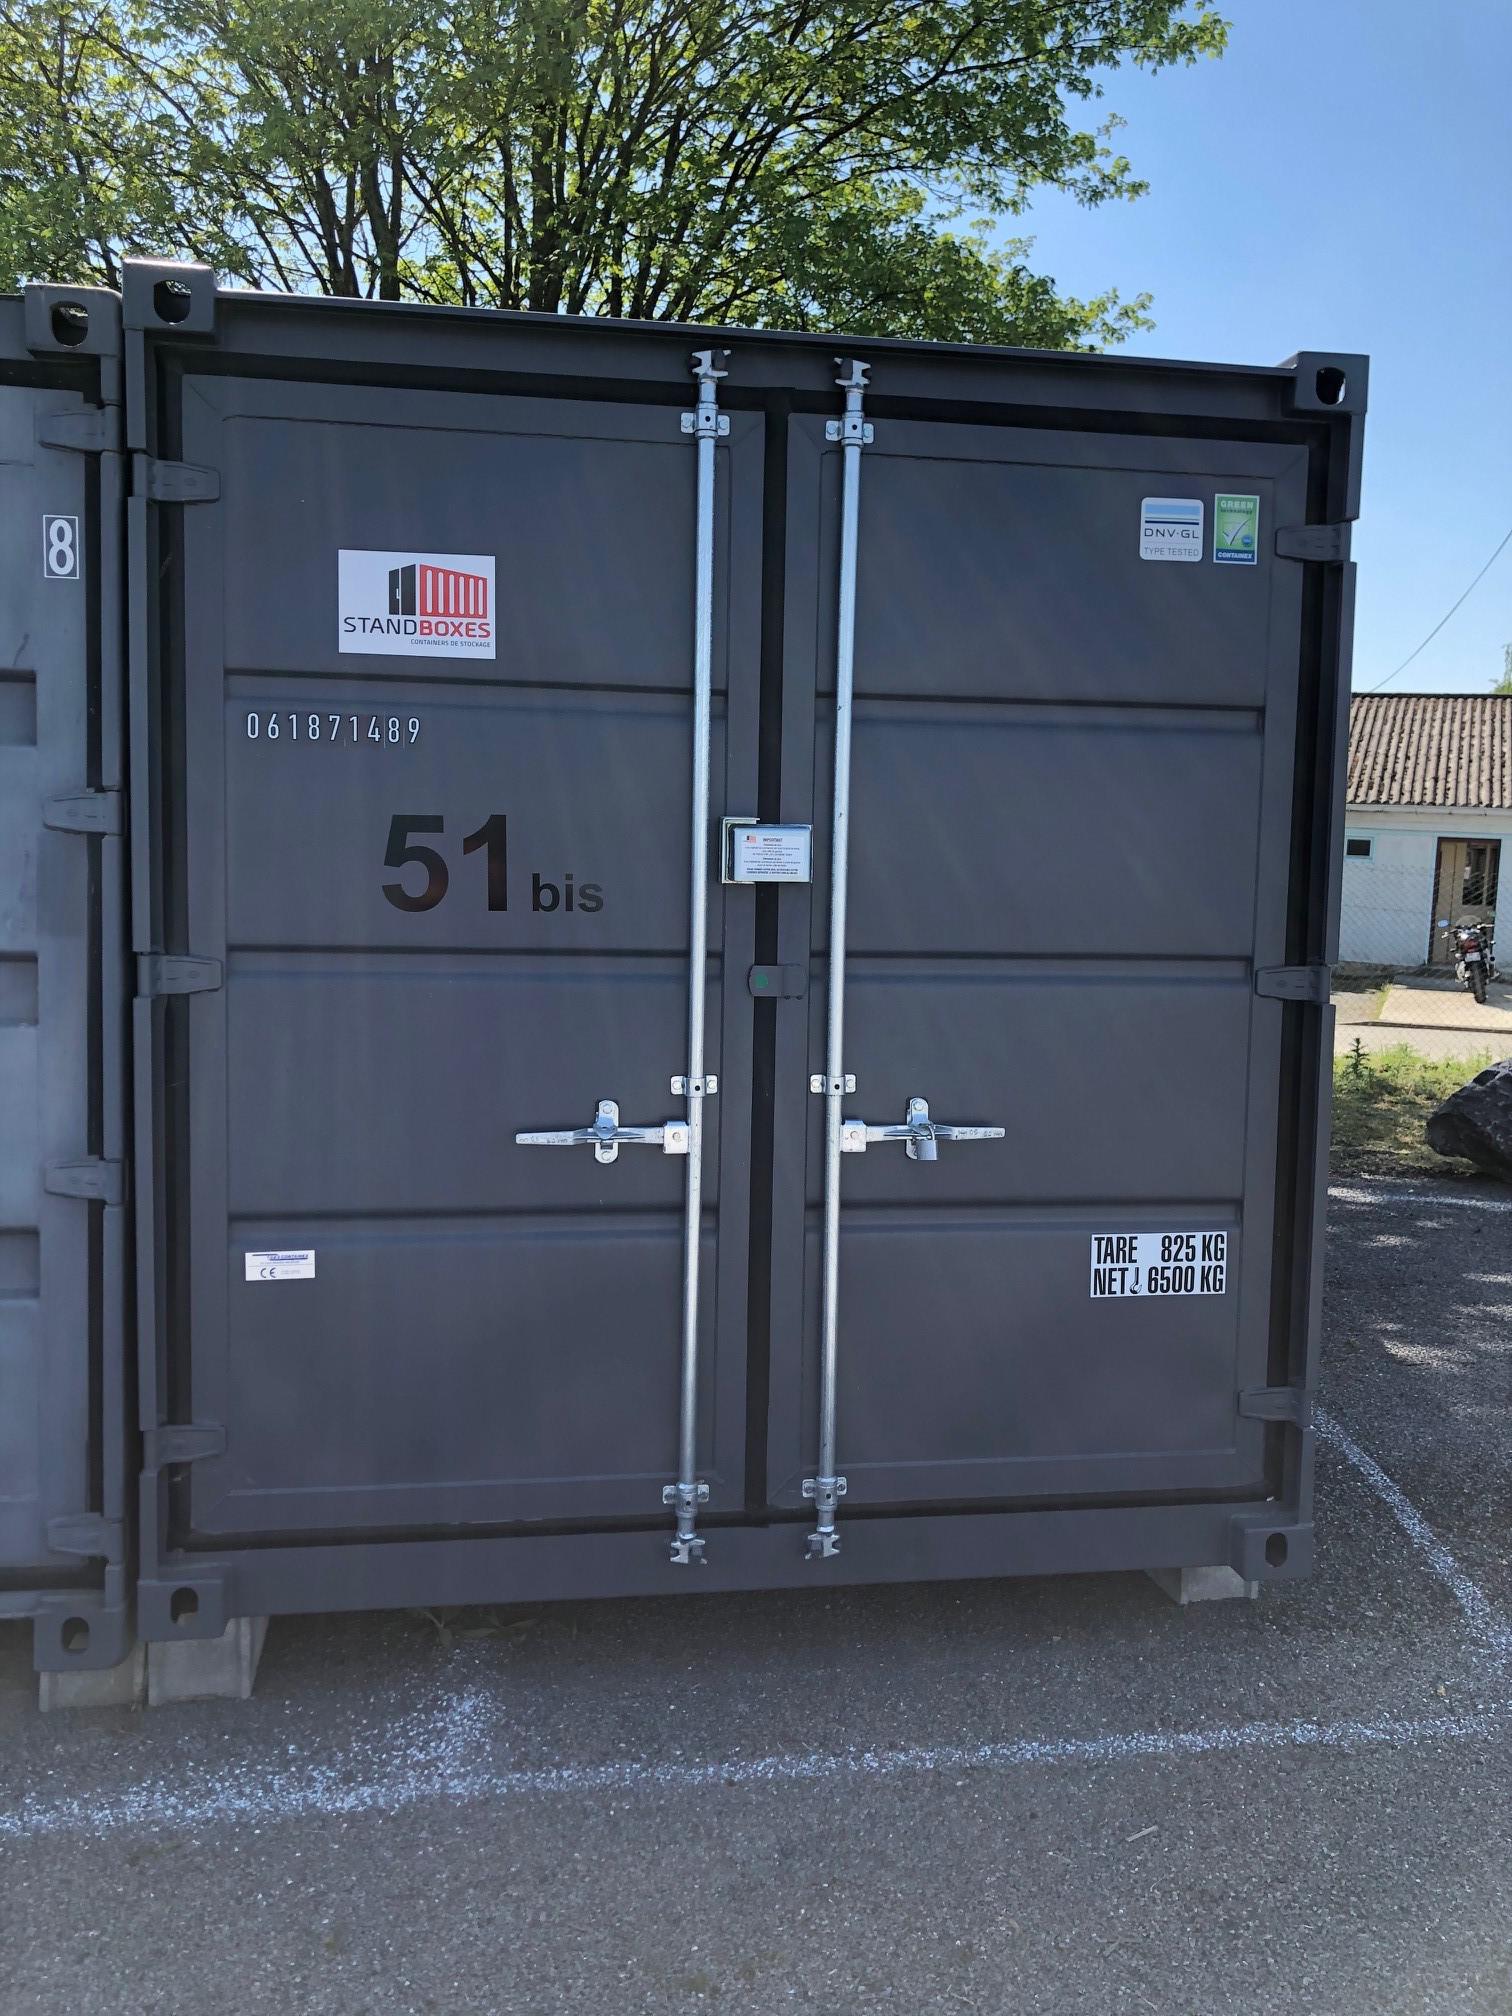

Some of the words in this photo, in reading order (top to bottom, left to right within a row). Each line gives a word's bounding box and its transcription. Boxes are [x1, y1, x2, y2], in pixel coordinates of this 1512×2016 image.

[1220, 500, 1254, 509] GREEN
[48, 518, 75, 575] 8
[1144, 546, 1165, 556] TYPE
[1167, 547, 1199, 557] TESTED
[1217, 551, 1253, 559] CONTAINEX
[410, 638, 449, 647] CONTAINERS
[247, 712, 420, 743] 061871489
[381, 814, 508, 913] 51
[532, 872, 604, 913] bis
[1093, 1236, 1138, 1264] TARE
[1161, 1234, 1196, 1263] 825
[1201, 1234, 1225, 1262] KG
[1093, 1267, 1129, 1295] NET
[1147, 1265, 1195, 1293] 6500
[1200, 1264, 1224, 1293] KG
